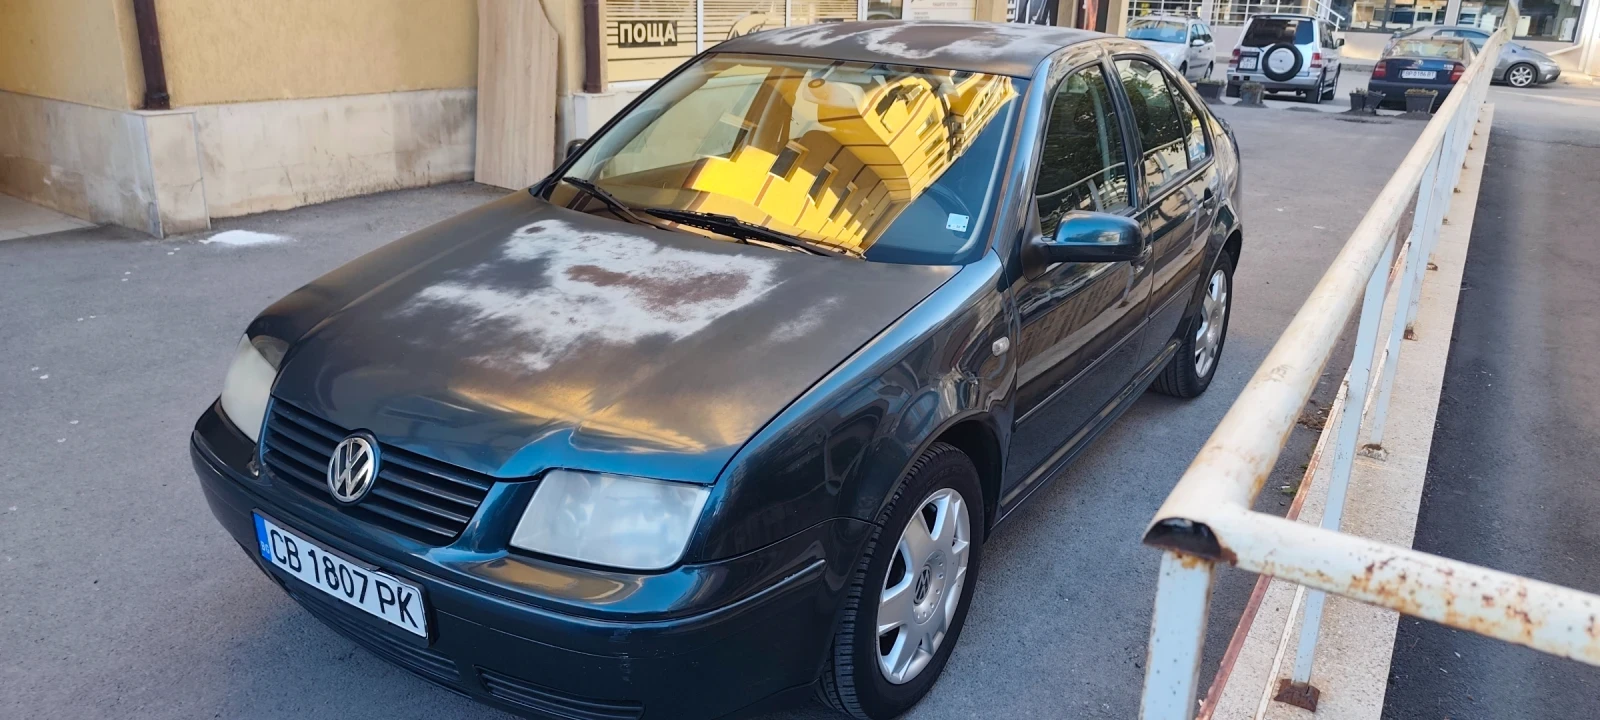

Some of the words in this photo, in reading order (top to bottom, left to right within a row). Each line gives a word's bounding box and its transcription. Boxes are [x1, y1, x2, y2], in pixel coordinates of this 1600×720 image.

[620, 22, 676, 46] ПОЩА
[260, 540, 270, 554] BG
[270, 529, 302, 573] CB
[308, 549, 368, 604] 1807
[375, 579, 418, 629] PK
